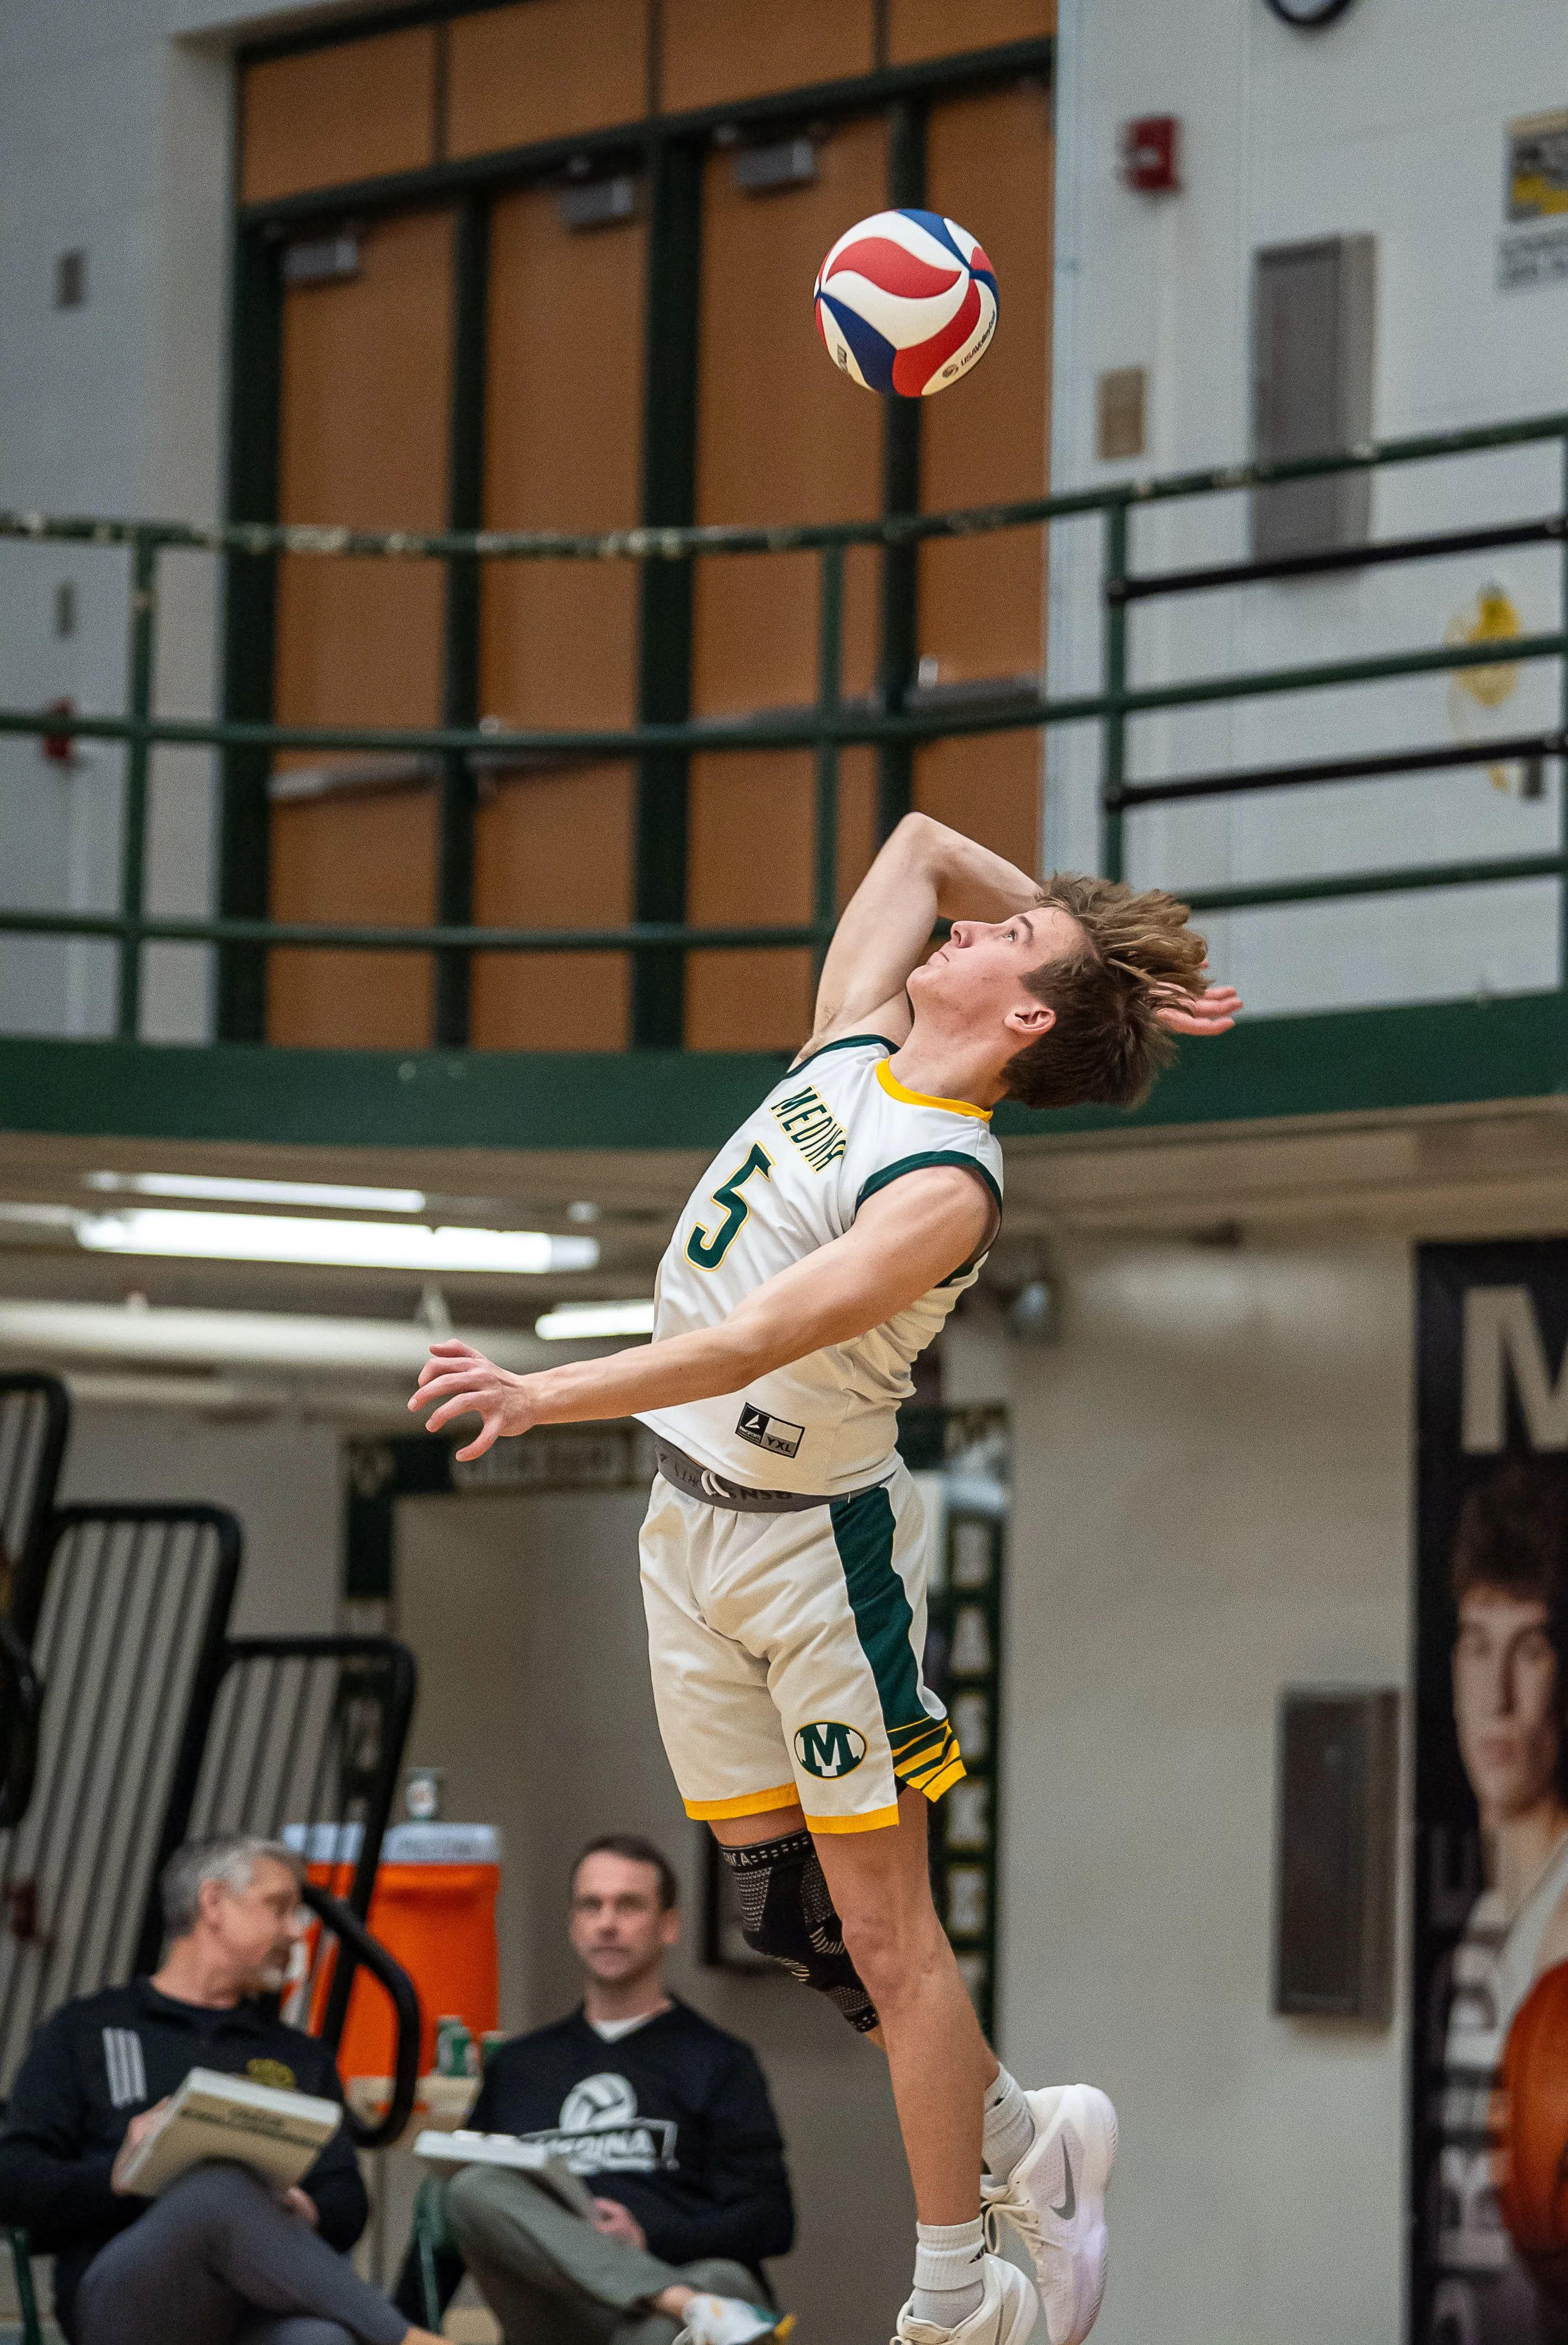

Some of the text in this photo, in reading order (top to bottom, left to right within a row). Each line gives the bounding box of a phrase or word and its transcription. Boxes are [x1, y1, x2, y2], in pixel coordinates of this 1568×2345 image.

[769, 1084, 847, 1173] MEDINA
[684, 1140, 776, 1272] 5
[767, 1436, 791, 1452] YXL
[797, 1721, 866, 1779] M
